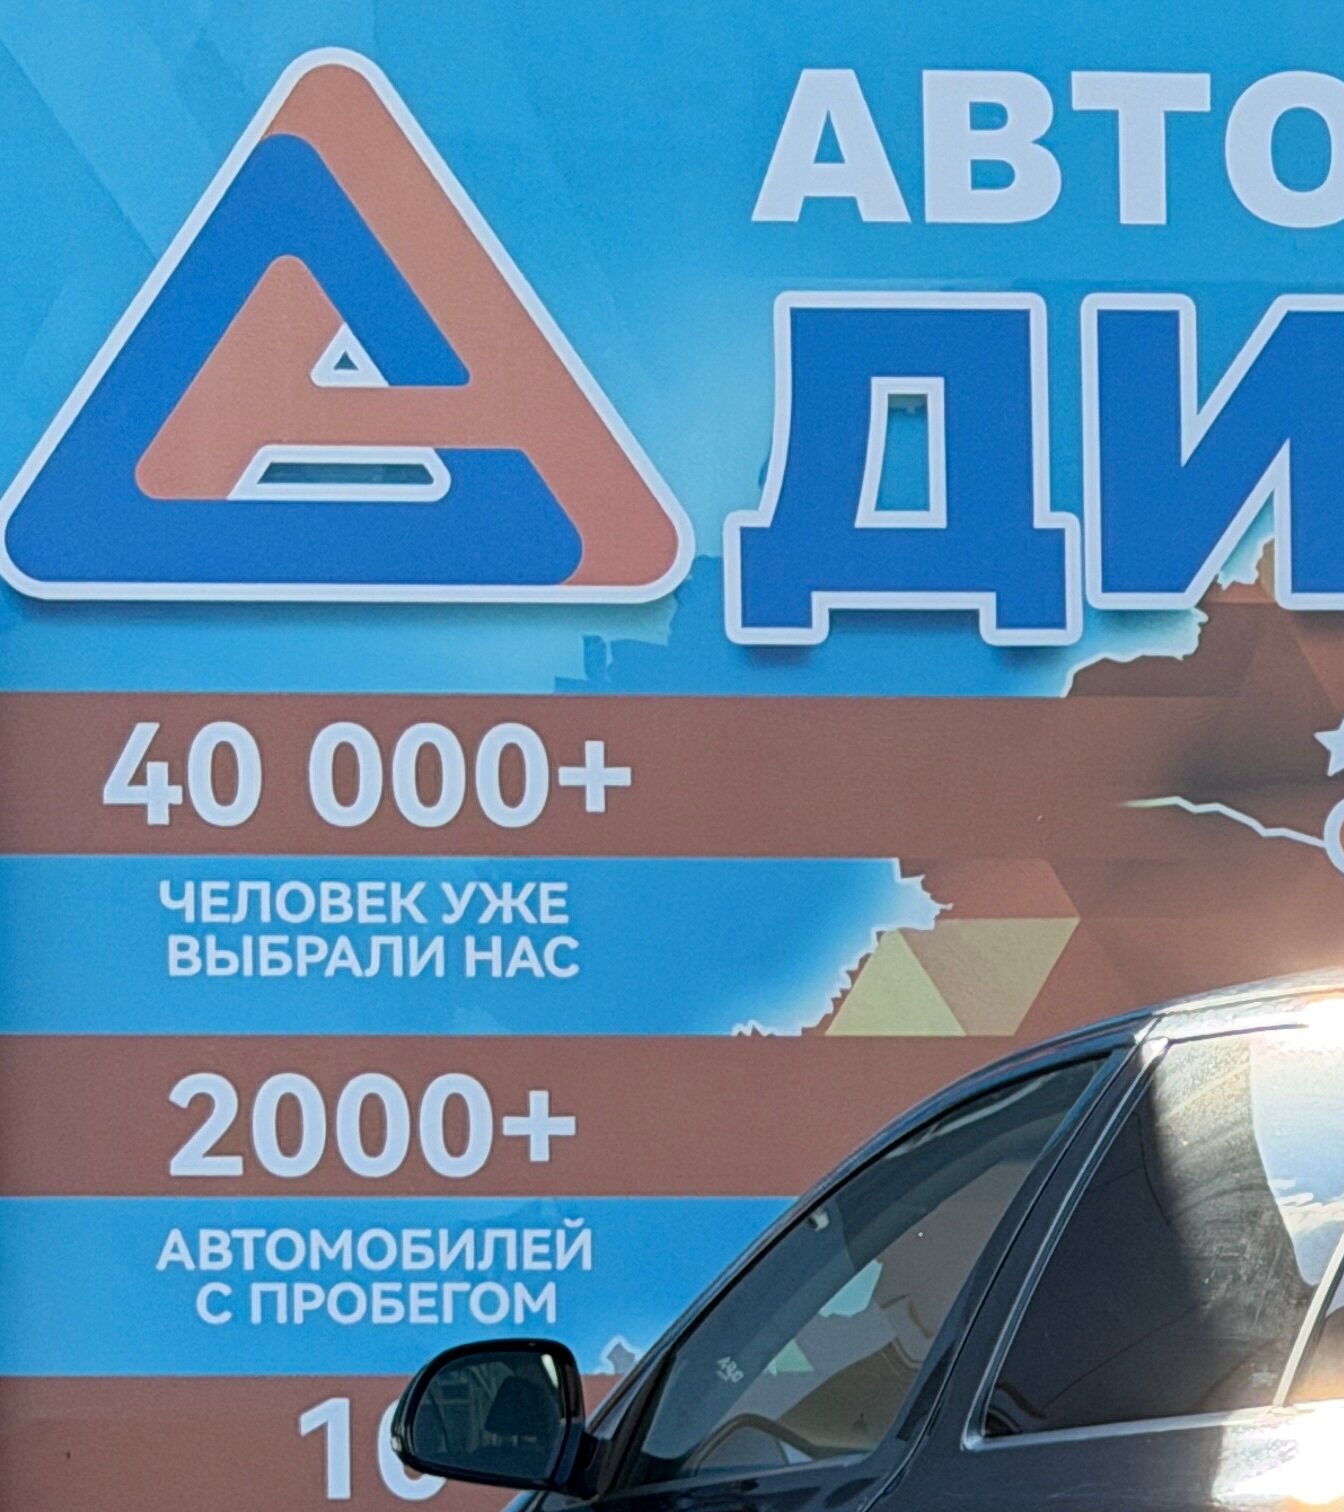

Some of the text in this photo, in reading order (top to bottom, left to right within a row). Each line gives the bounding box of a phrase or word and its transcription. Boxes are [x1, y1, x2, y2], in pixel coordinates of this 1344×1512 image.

[101, 720, 633, 829] 40 000+
[159, 880, 569, 925] ЧЕЛОВЕК УЖЕ
[168, 934, 579, 978] ВЫБРАЛИ НАС
[167, 1071, 577, 1179] 2000+
[157, 1216, 593, 1271] АВТОМОБИЛЕЙ
[196, 1281, 557, 1324] С ПРОБЕГОМ
